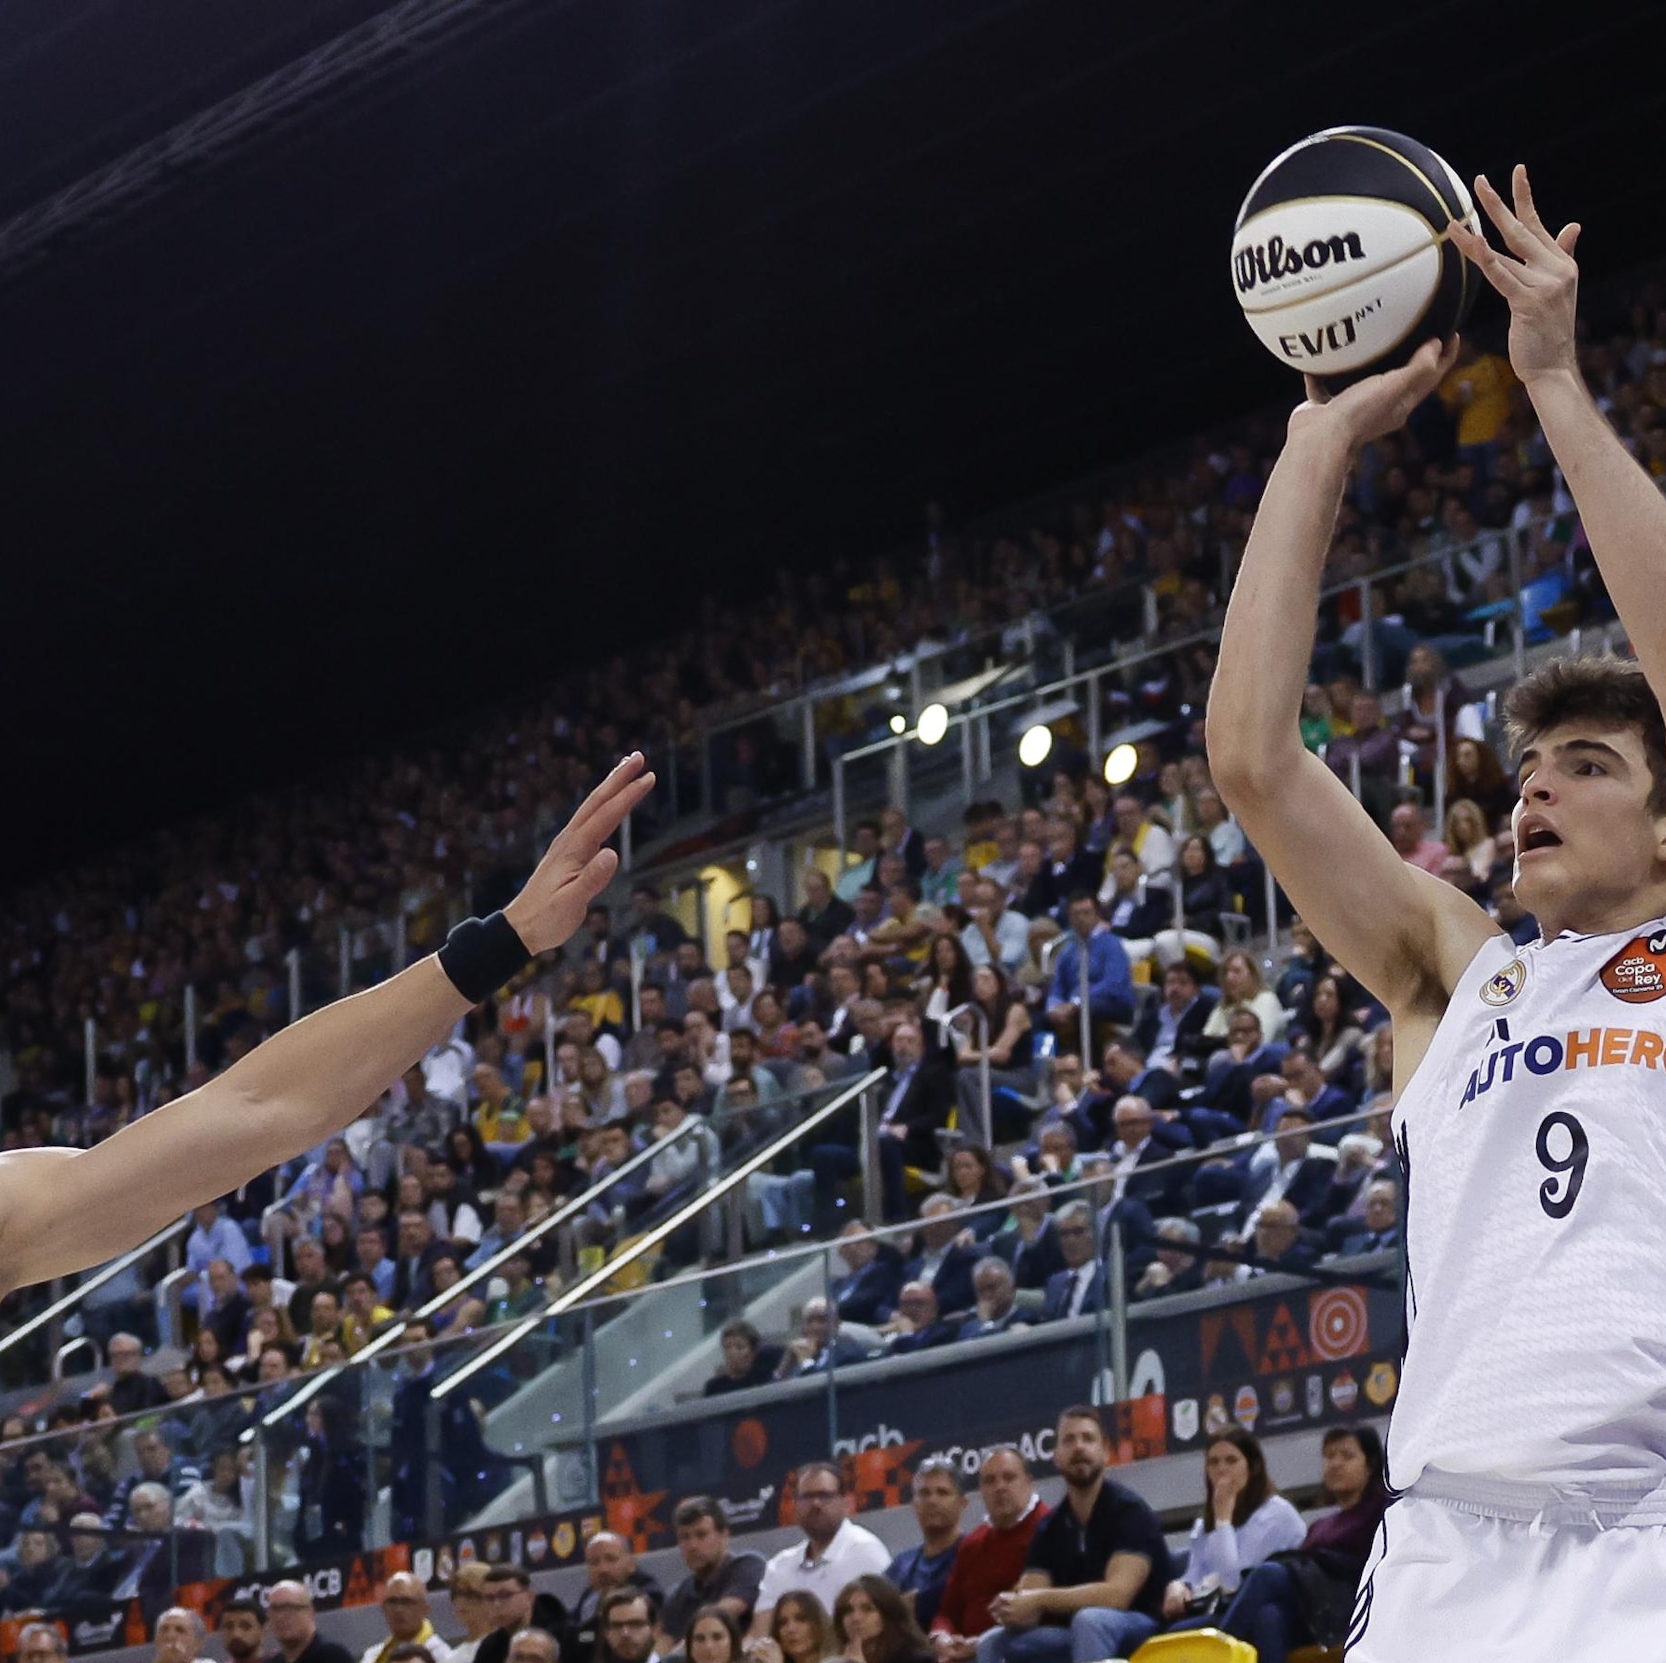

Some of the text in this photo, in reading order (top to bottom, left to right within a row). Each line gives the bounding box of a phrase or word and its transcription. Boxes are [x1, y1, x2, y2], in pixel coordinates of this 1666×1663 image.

[1235, 231, 1366, 293] Wilson
[1623, 956, 1644, 966] acb
[1615, 963, 1655, 976] Copa
[1635, 973, 1661, 985] Rey
[1535, 1111, 1589, 1219] 9
